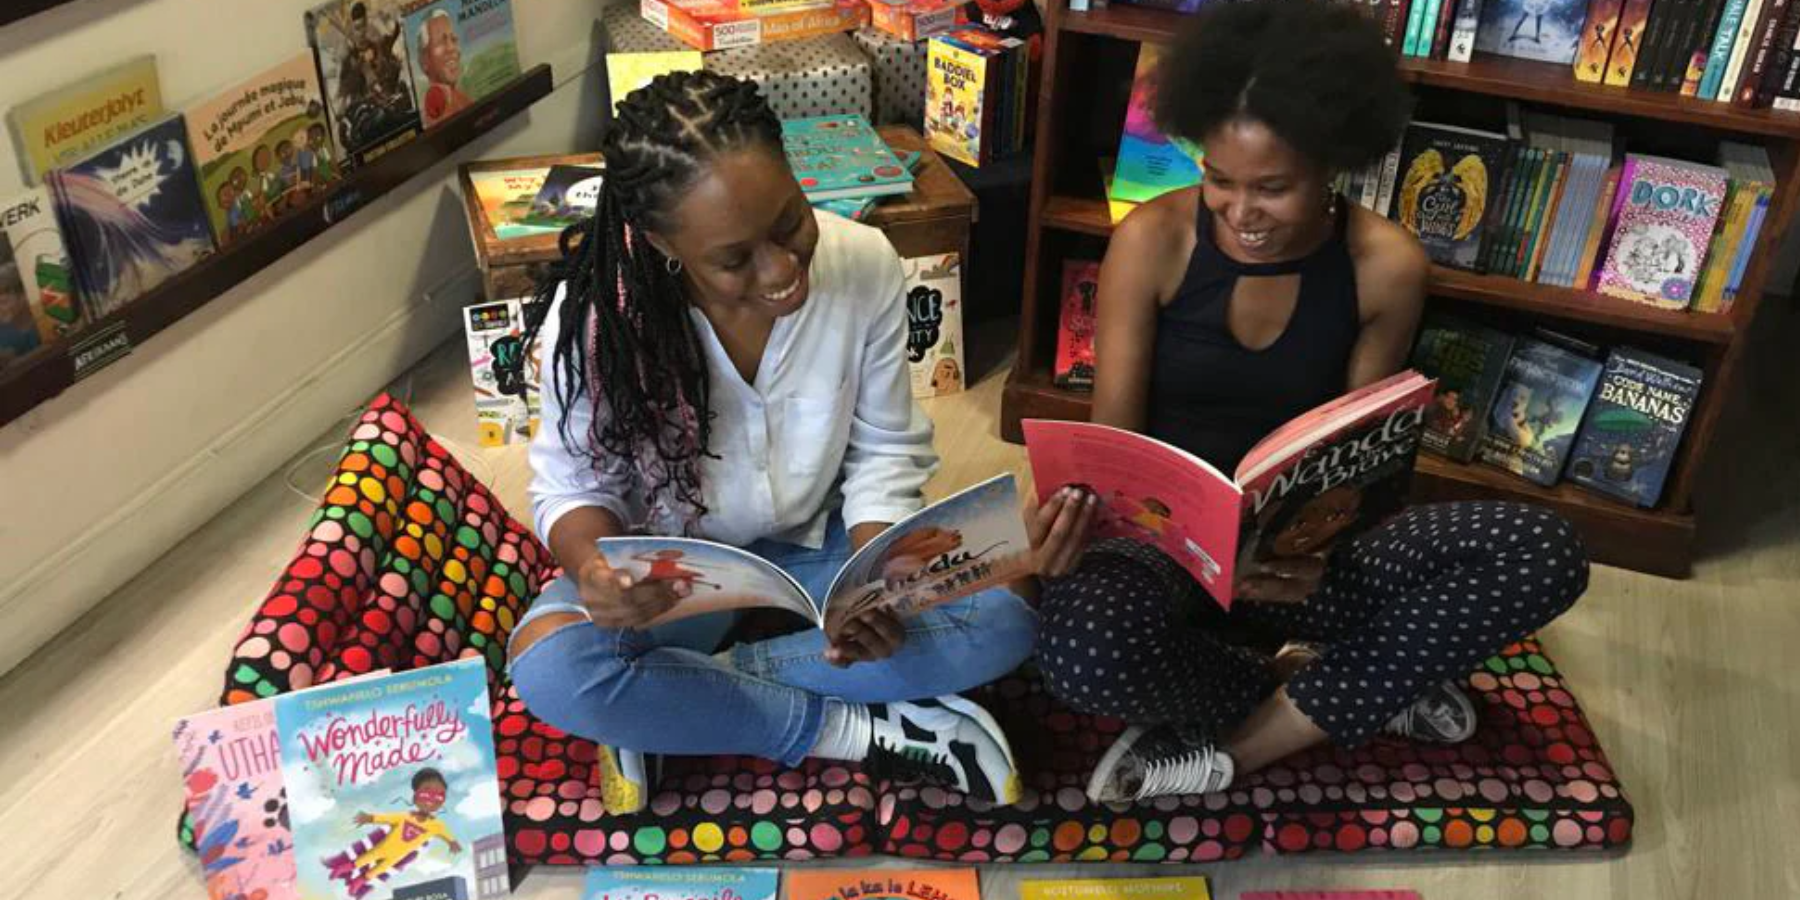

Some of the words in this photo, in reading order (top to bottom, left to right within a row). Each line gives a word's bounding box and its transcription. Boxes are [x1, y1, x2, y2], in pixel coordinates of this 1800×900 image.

[934, 56, 976, 83] BADDIEL
[943, 73, 966, 91] BOX
[203, 122, 218, 141] La
[214, 136, 228, 152] de
[226, 106, 262, 137] Mpumi
[264, 100, 275, 113] et
[1630, 179, 1719, 218] DORK
[1600, 382, 1685, 424] BANANAS
[1613, 374, 1645, 393] CODE
[1646, 386, 1681, 406] NAME
[1250, 403, 1425, 514] Wanda
[1314, 437, 1414, 495] Brave
[298, 700, 467, 763] Wonderfully
[333, 738, 437, 787] Made
